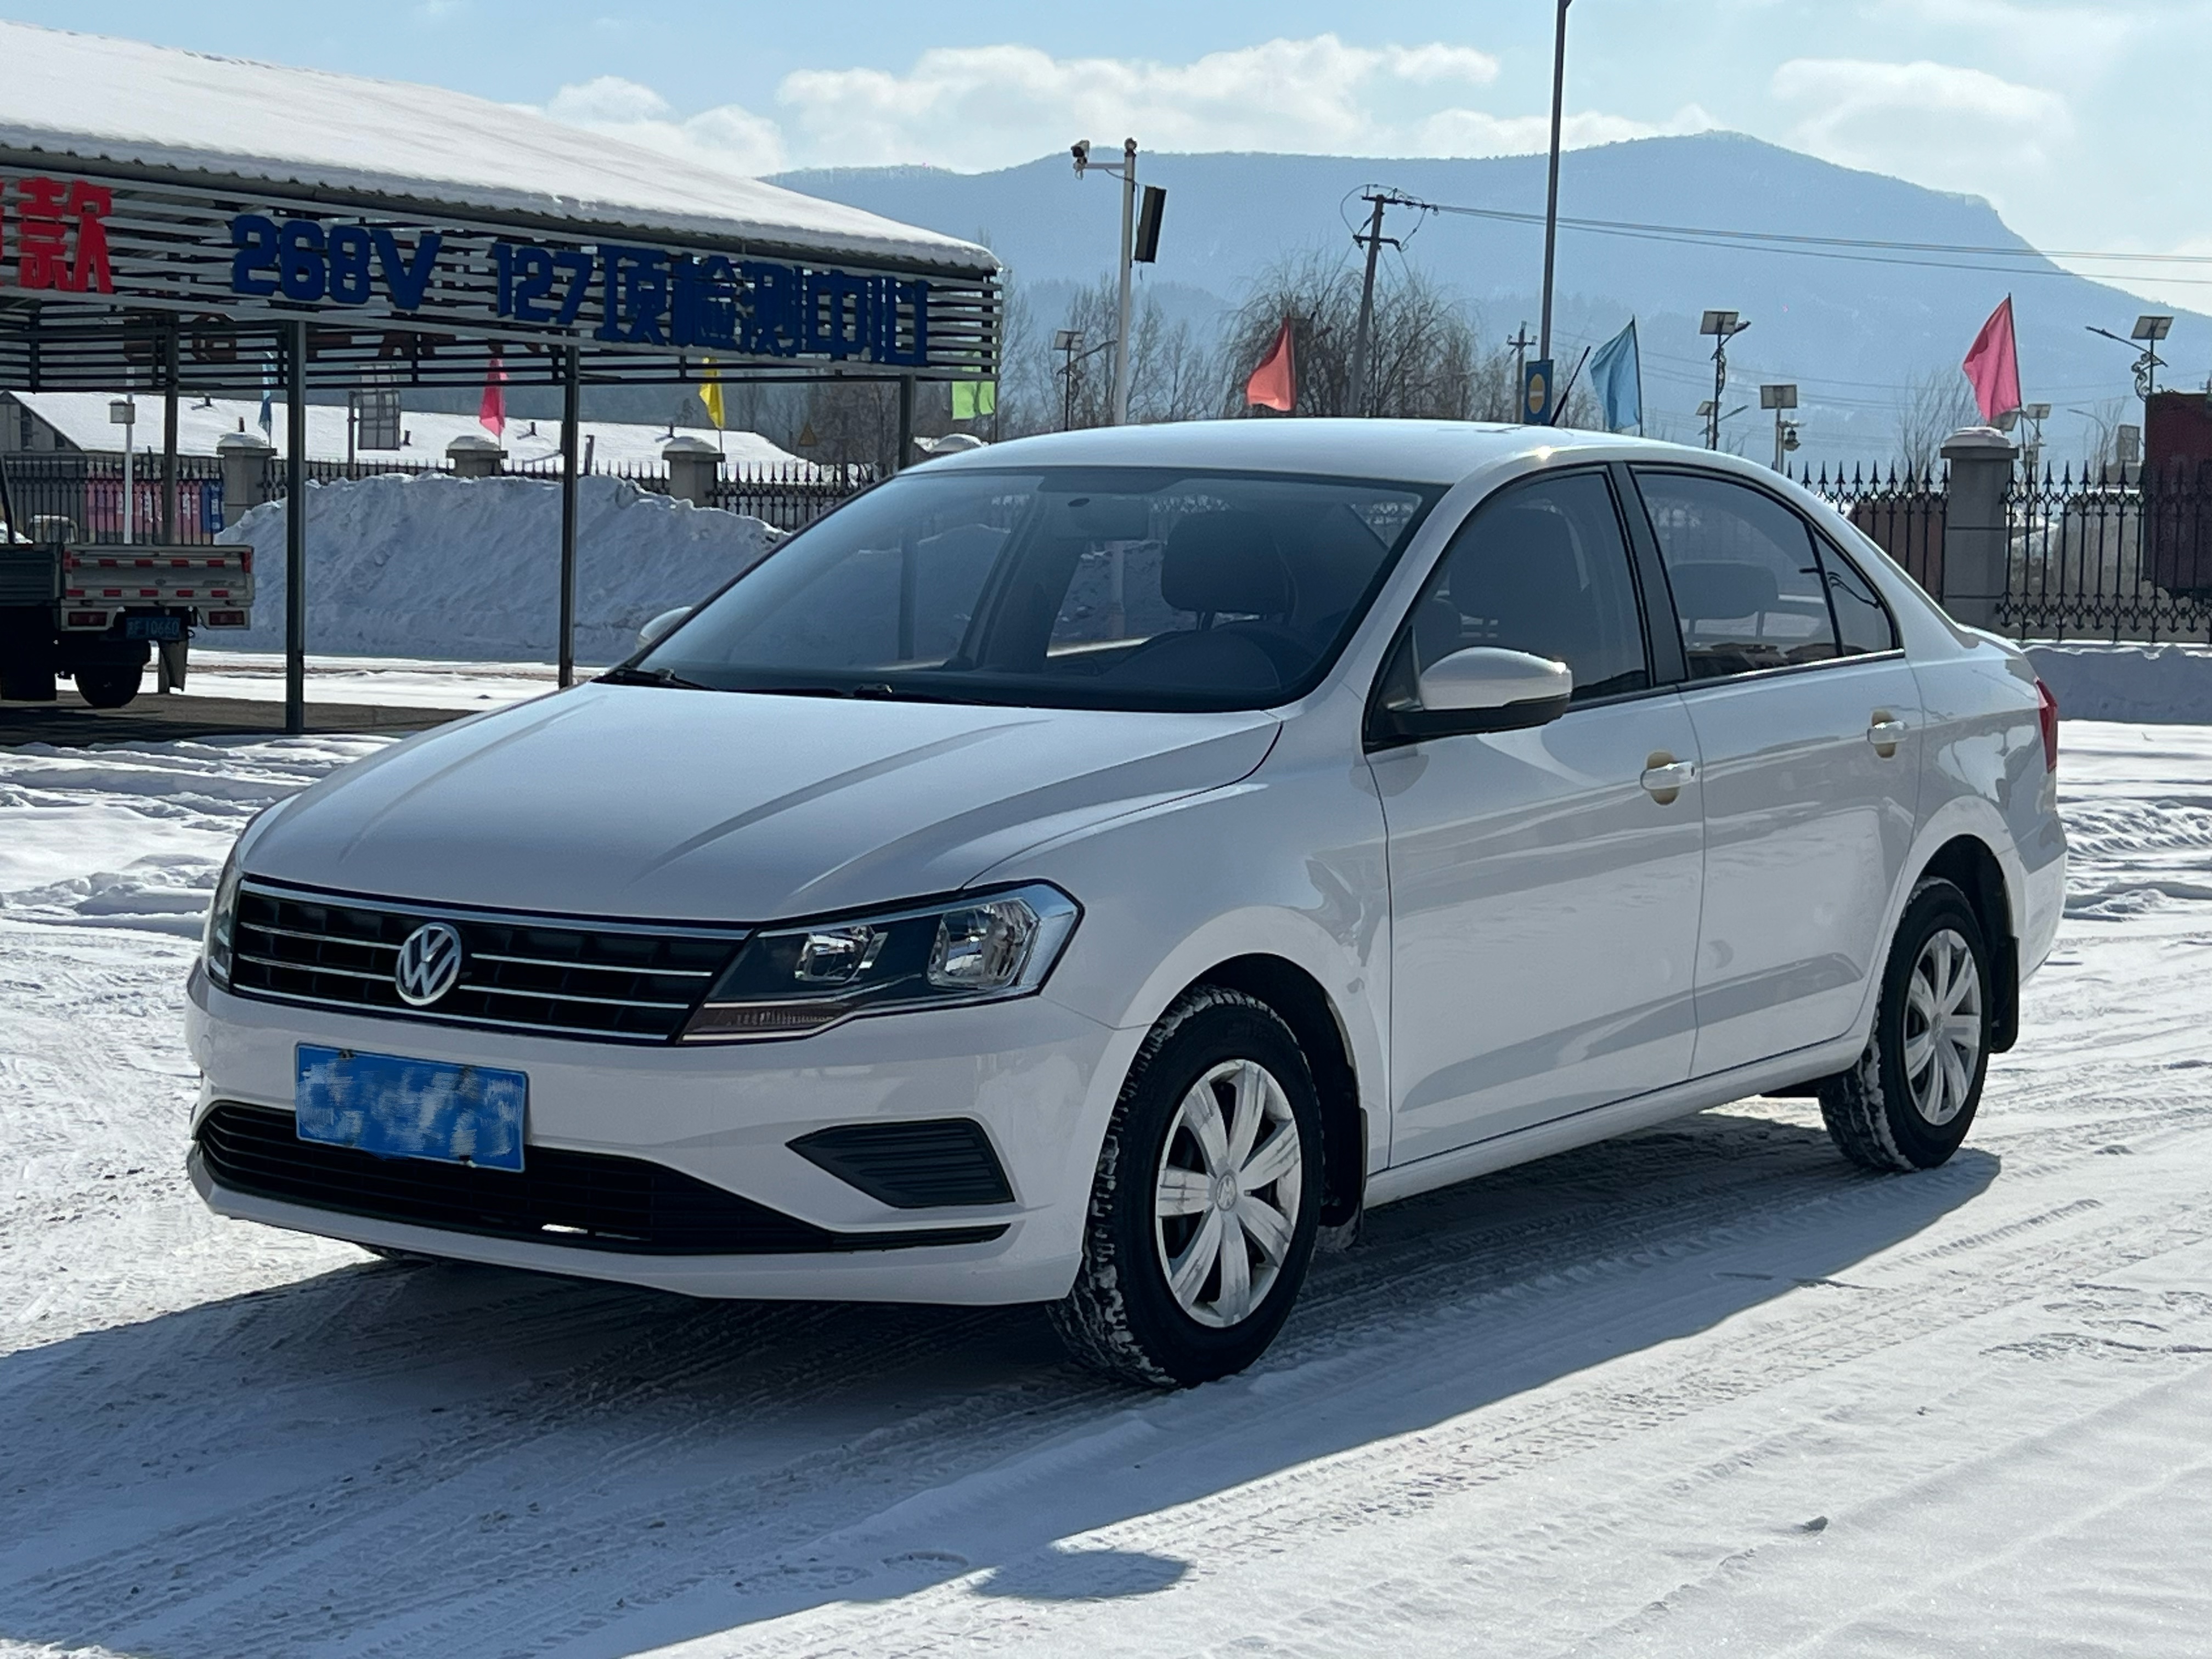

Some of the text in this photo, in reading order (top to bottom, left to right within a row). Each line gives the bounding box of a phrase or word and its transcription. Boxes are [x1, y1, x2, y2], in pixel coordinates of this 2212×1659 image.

[0, 176, 114, 294] 款
[232, 213, 441, 310] 268V
[398, 924, 461, 1004] VW
